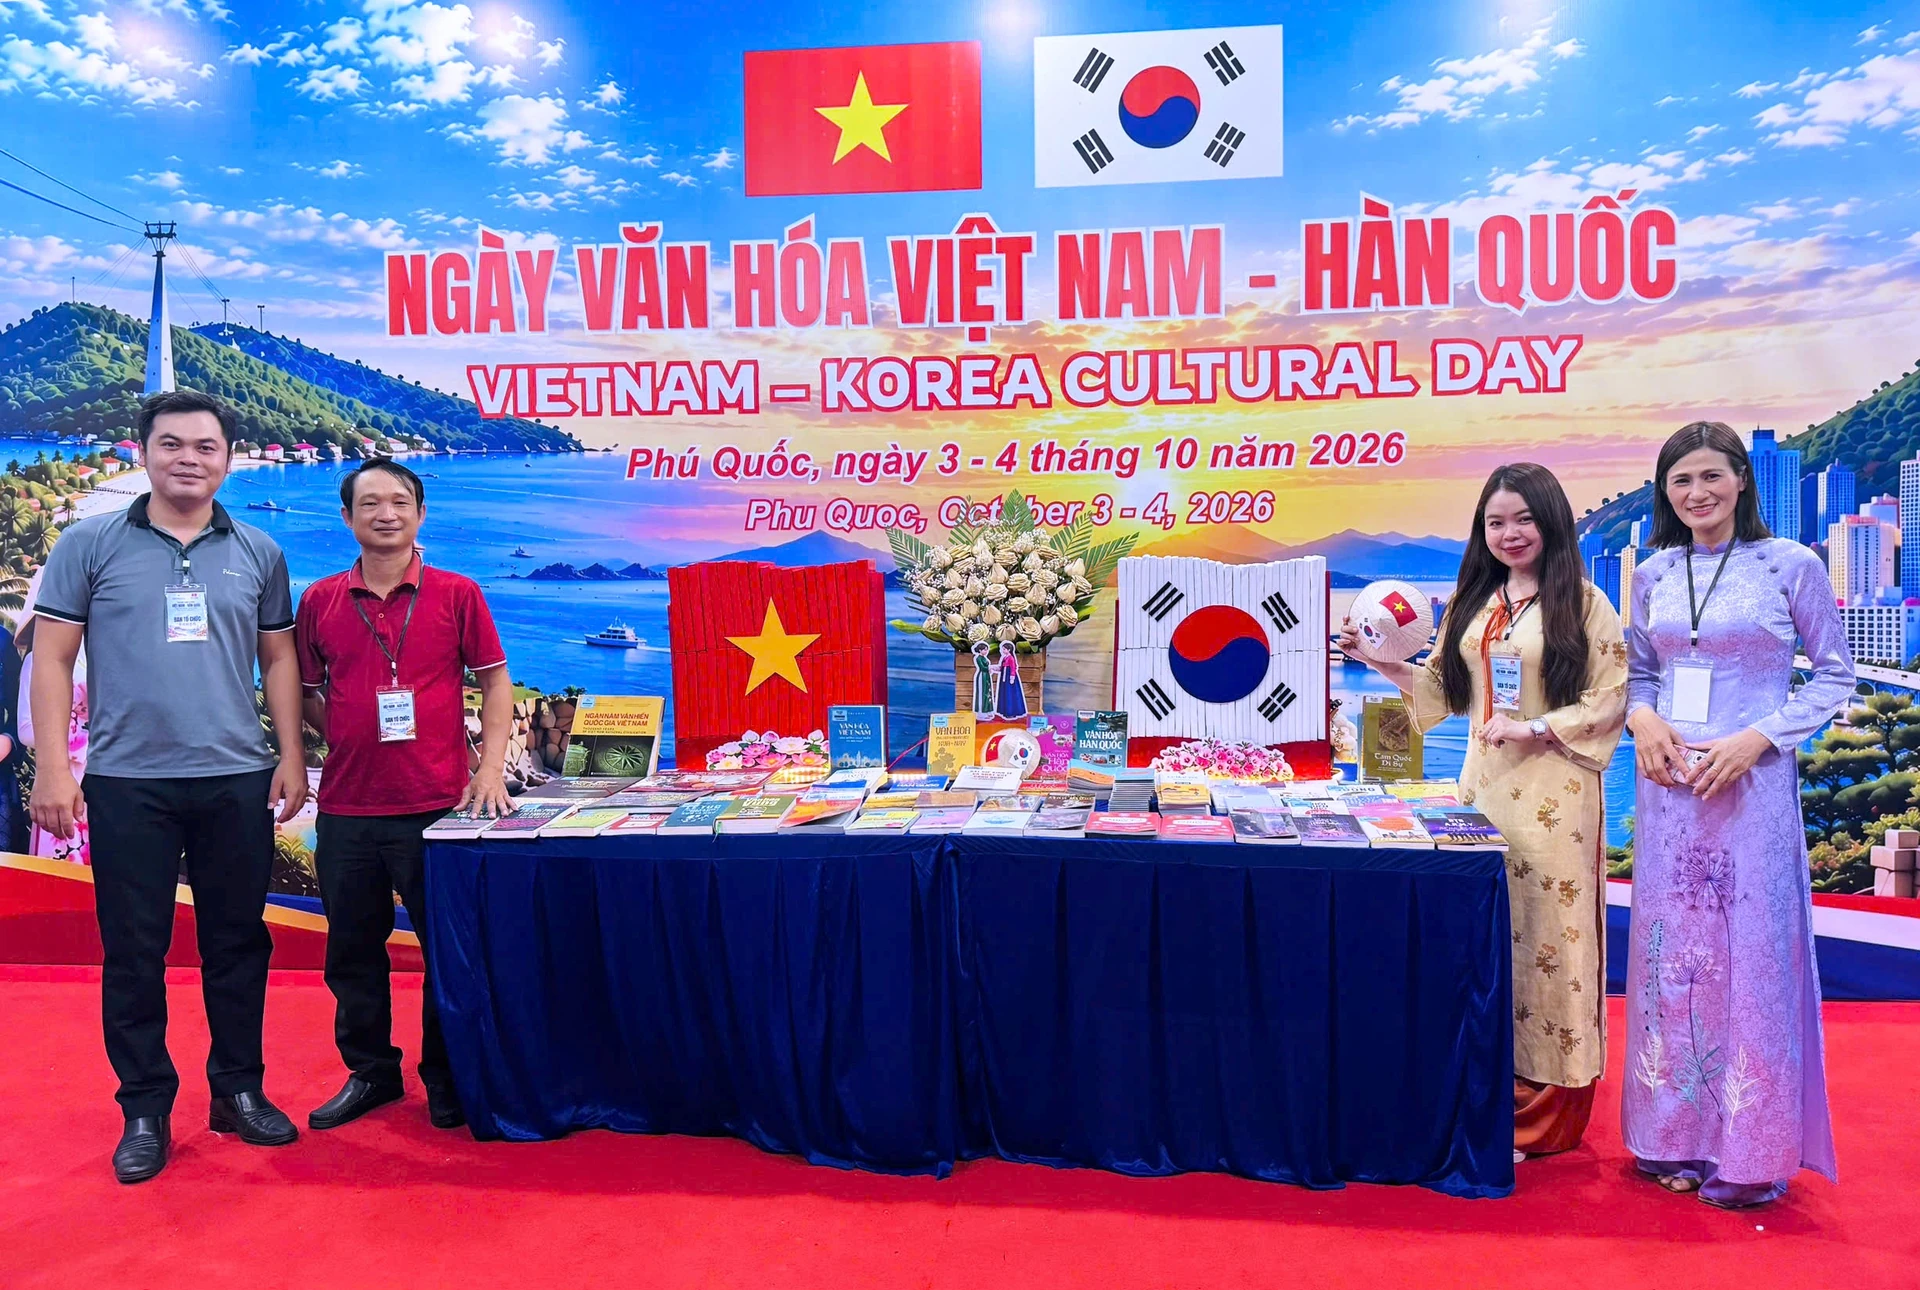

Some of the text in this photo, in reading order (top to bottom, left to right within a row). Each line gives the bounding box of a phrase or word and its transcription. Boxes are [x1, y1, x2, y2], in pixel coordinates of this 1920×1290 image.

[385, 188, 1678, 342] NGÀY VĂN HÓA VIỆT NAM - HÀN QUỐC
[468, 360, 758, 417] VIETNAM
[821, 354, 1052, 412] KOREA
[1061, 341, 1420, 406] CULTURAL
[1431, 334, 1583, 395] DAY
[626, 431, 1406, 484] Phú Quốc, ngày 3 - 4 tháng 10 năm 2026
[745, 490, 1275, 533] Phu Quoc, Octber 3 - 4, 2026
